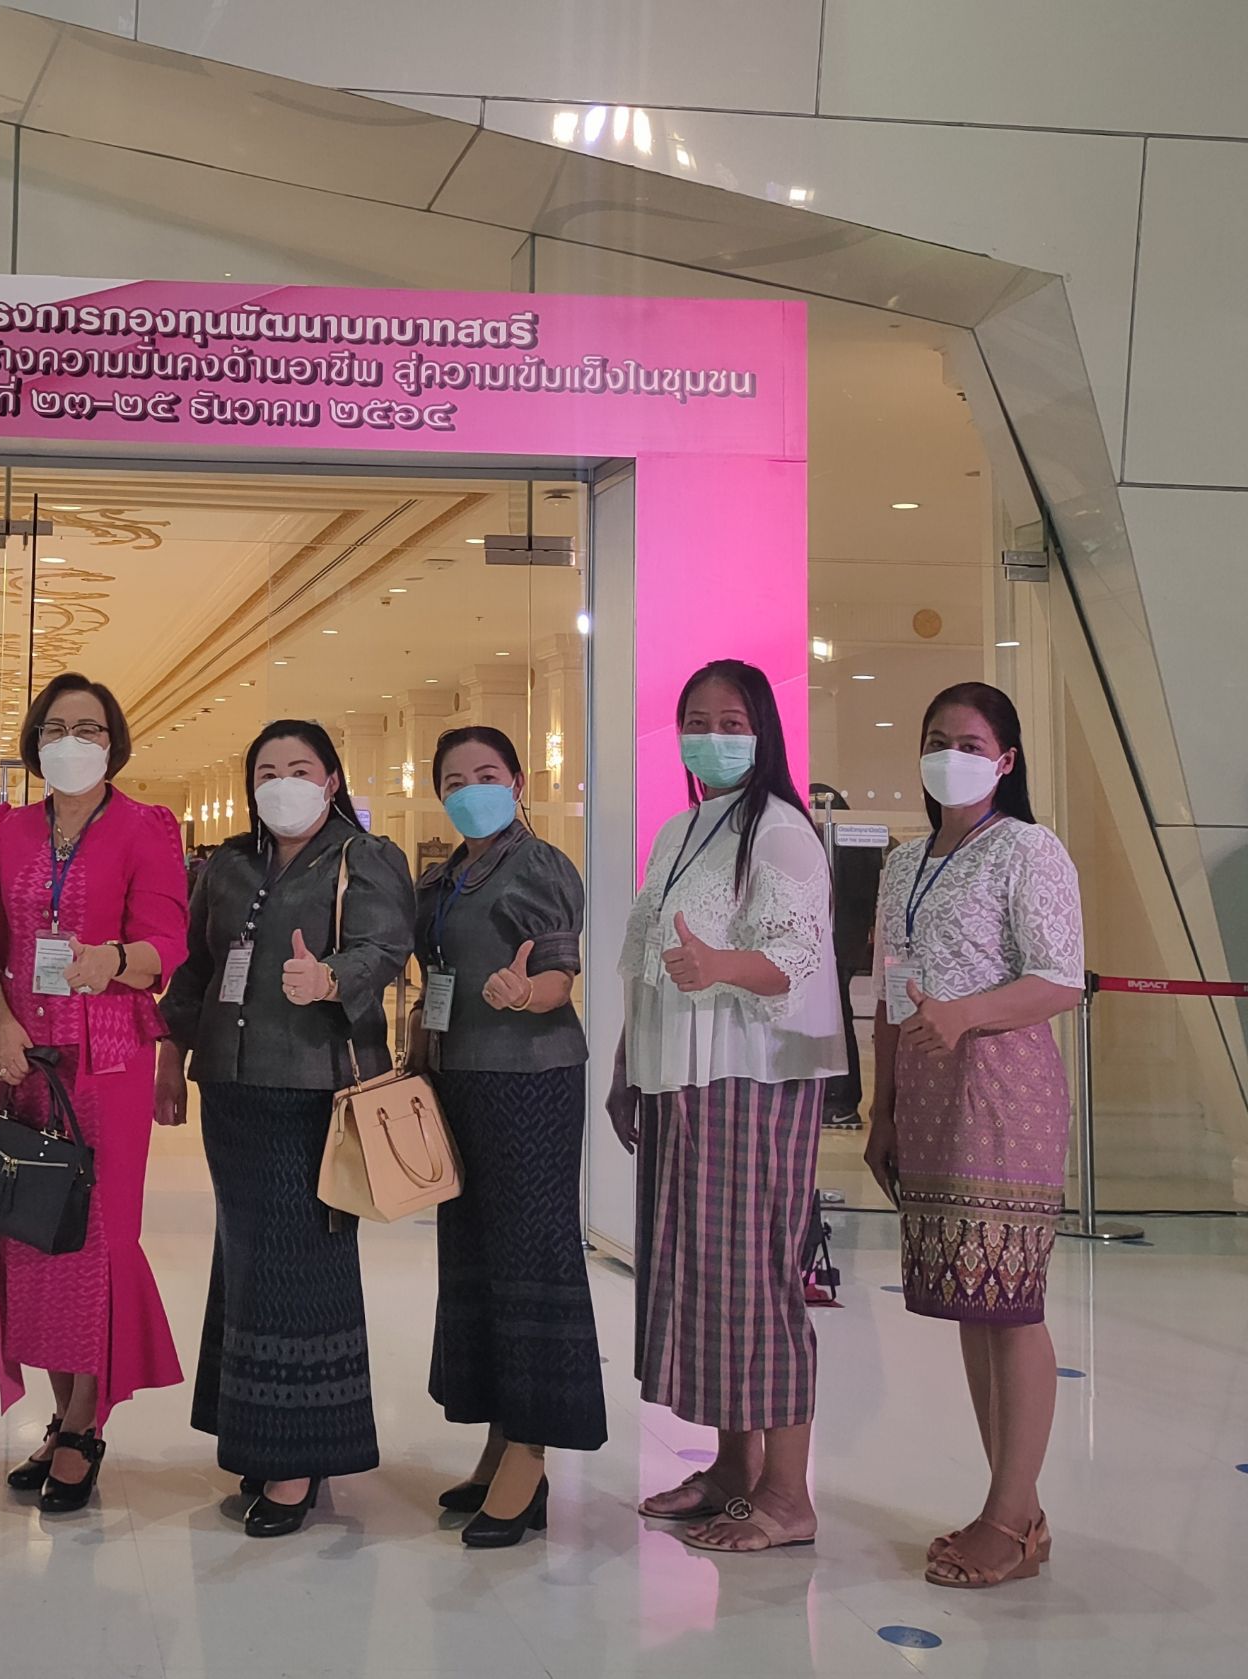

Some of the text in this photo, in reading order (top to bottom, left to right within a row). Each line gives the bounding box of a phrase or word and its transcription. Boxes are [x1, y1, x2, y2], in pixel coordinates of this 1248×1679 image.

[394, 352, 753, 400] สู่ความเข้มแข็งในชุมชน
[190, 391, 314, 421] ธันวาคม
[329, 399, 452, 426] ๒๕๖๔
[1127, 980, 1169, 991] IMPACT
